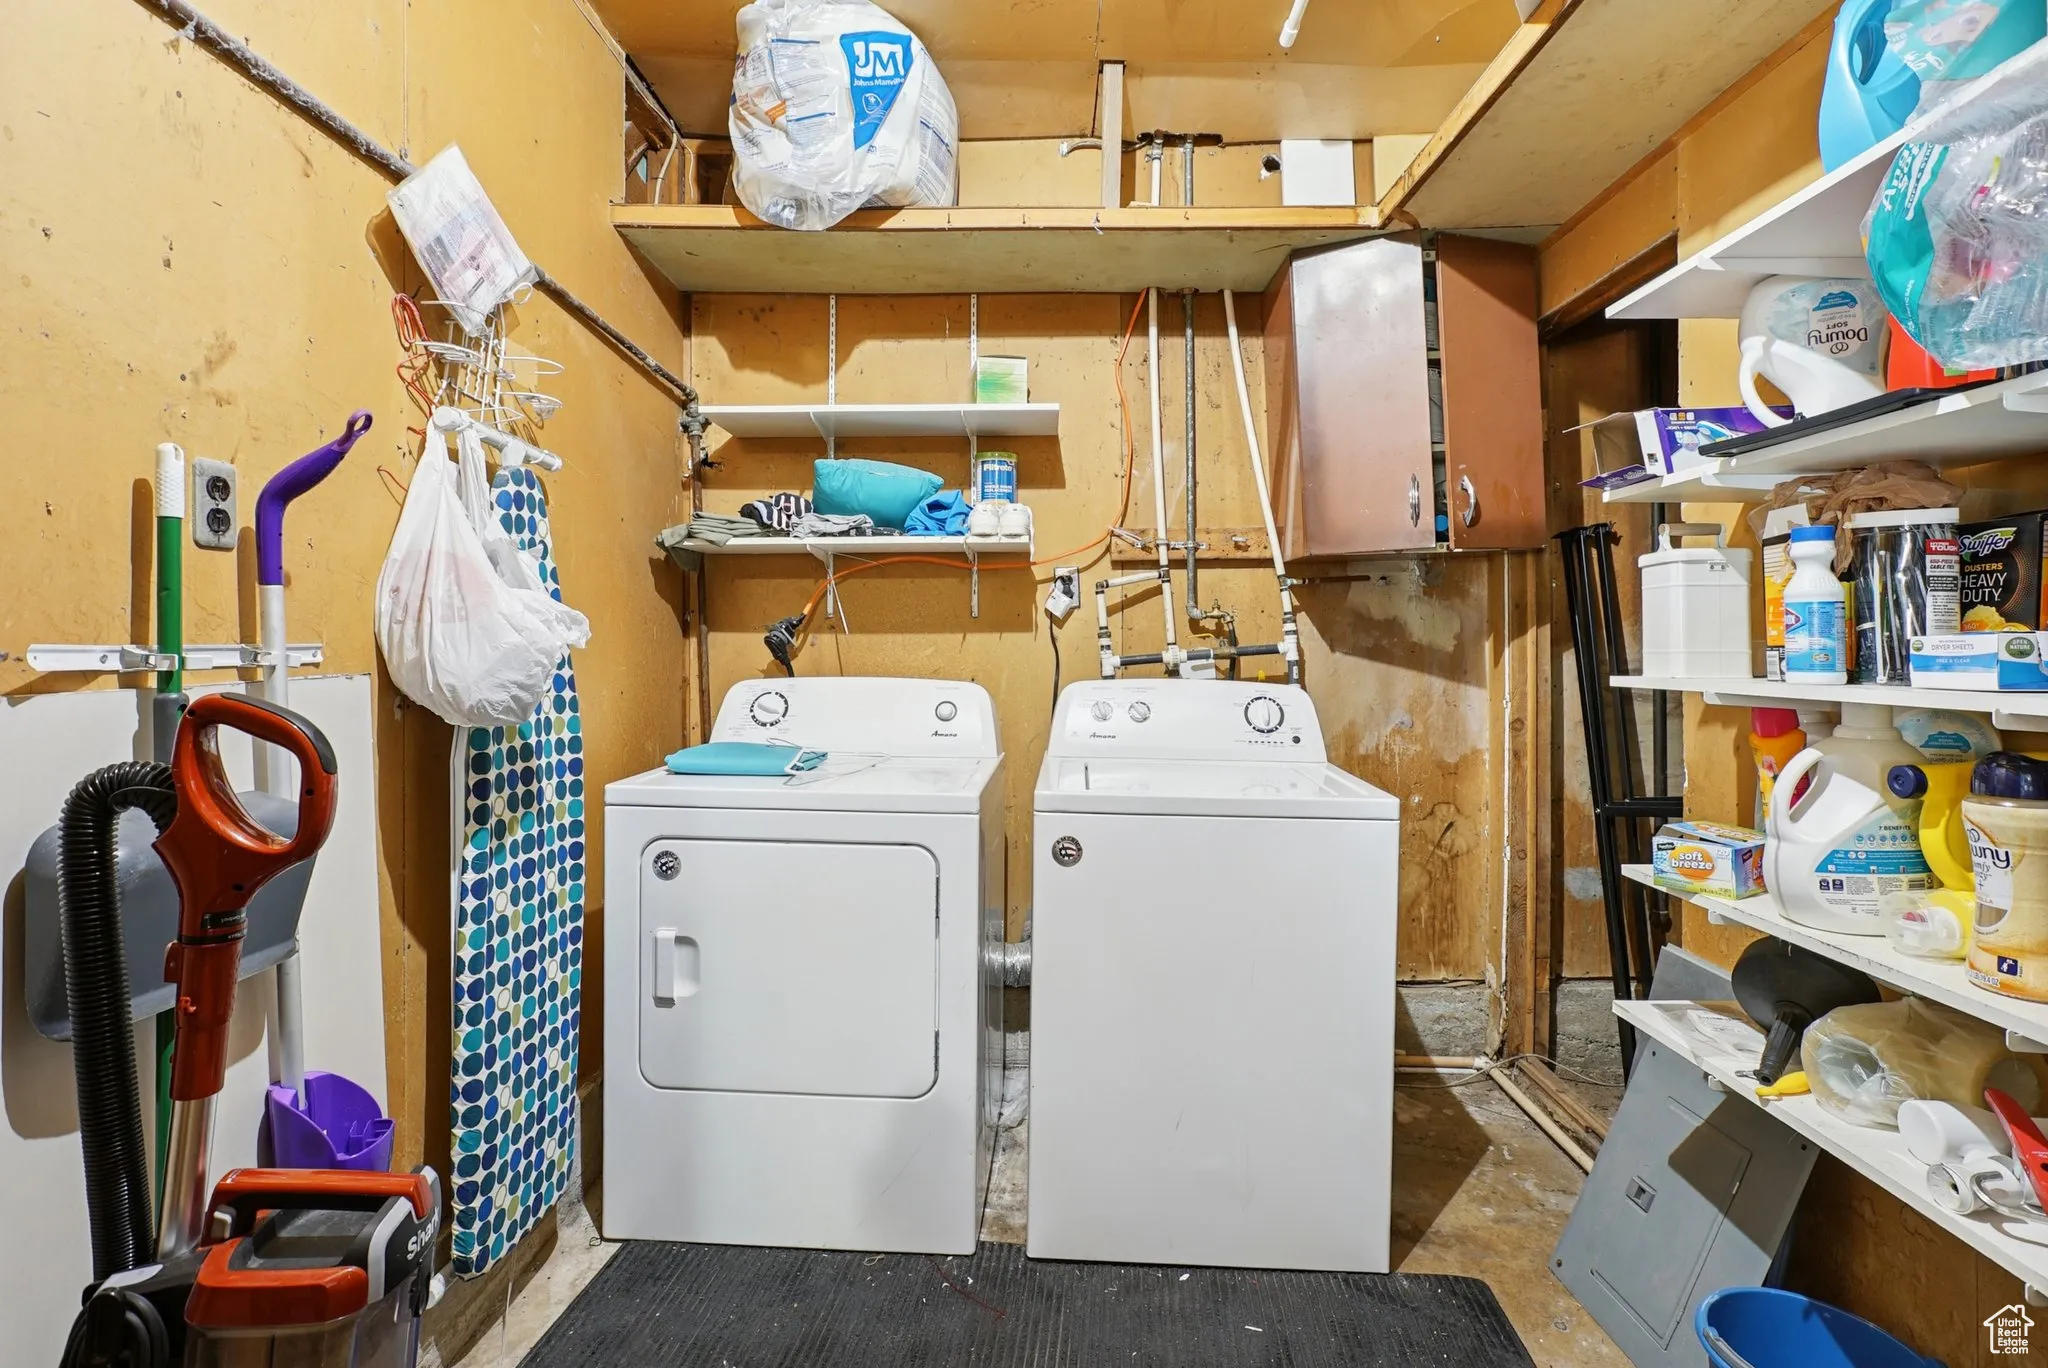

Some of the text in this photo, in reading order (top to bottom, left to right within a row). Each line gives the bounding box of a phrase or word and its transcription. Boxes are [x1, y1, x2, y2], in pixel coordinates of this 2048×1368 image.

[853, 41, 905, 77] JM
[854, 78, 874, 87] Johns
[1826, 321, 1848, 330] SOFT
[1807, 327, 1868, 346] Downy
[1959, 534, 2012, 556] Swiffer
[1964, 563, 2003, 572] DUSTERS
[1959, 572, 2007, 588] HEAVY
[1931, 643, 1951, 651] DRYER
[1952, 643, 1975, 651] SHEETS
[1680, 852, 1704, 861] soft
[1971, 844, 2011, 869] wny
[1671, 858, 1714, 870] breeze
